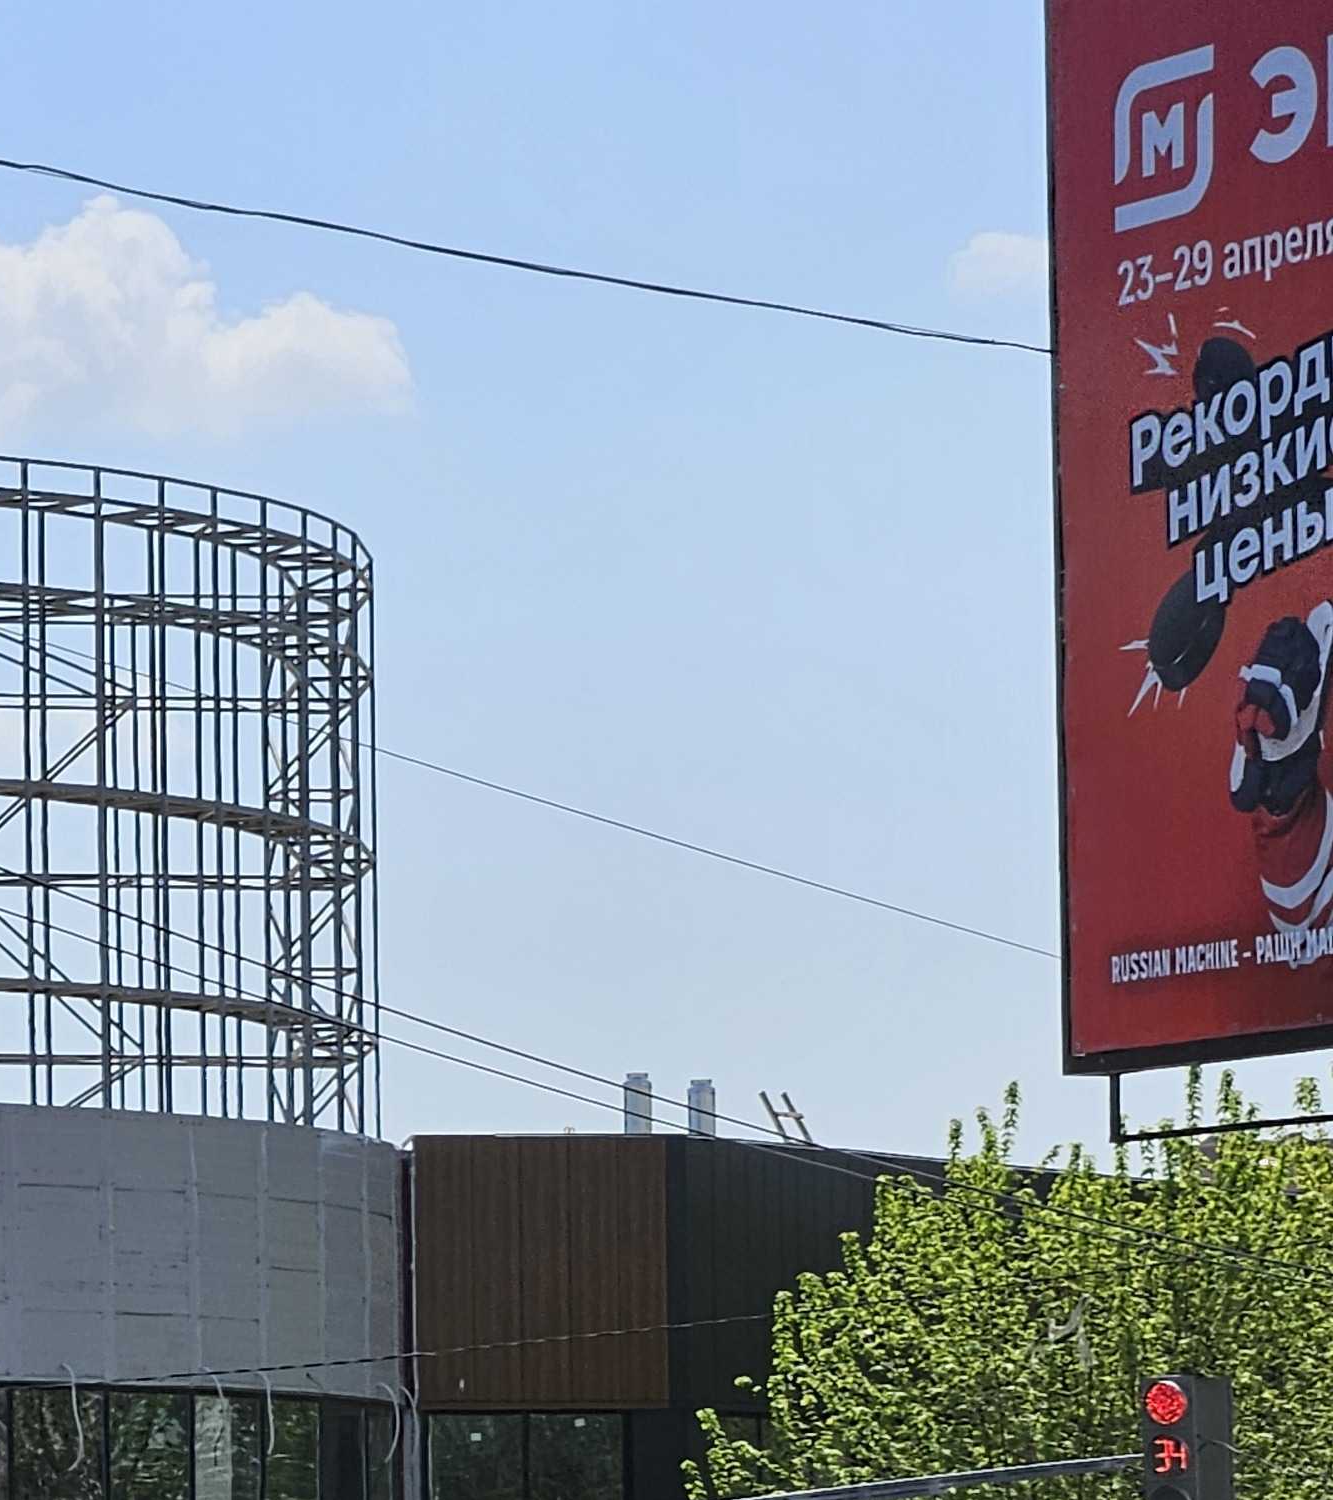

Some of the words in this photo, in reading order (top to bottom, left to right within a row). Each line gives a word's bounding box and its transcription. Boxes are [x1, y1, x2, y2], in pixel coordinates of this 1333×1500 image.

[1249, 34, 1333, 164] Э
[1131, 335, 1333, 487] Рекорд
[1168, 415, 1333, 543] низки
[1111, 949, 1171, 984] RUSSIAN
[1175, 939, 1239, 976] MACHINE
